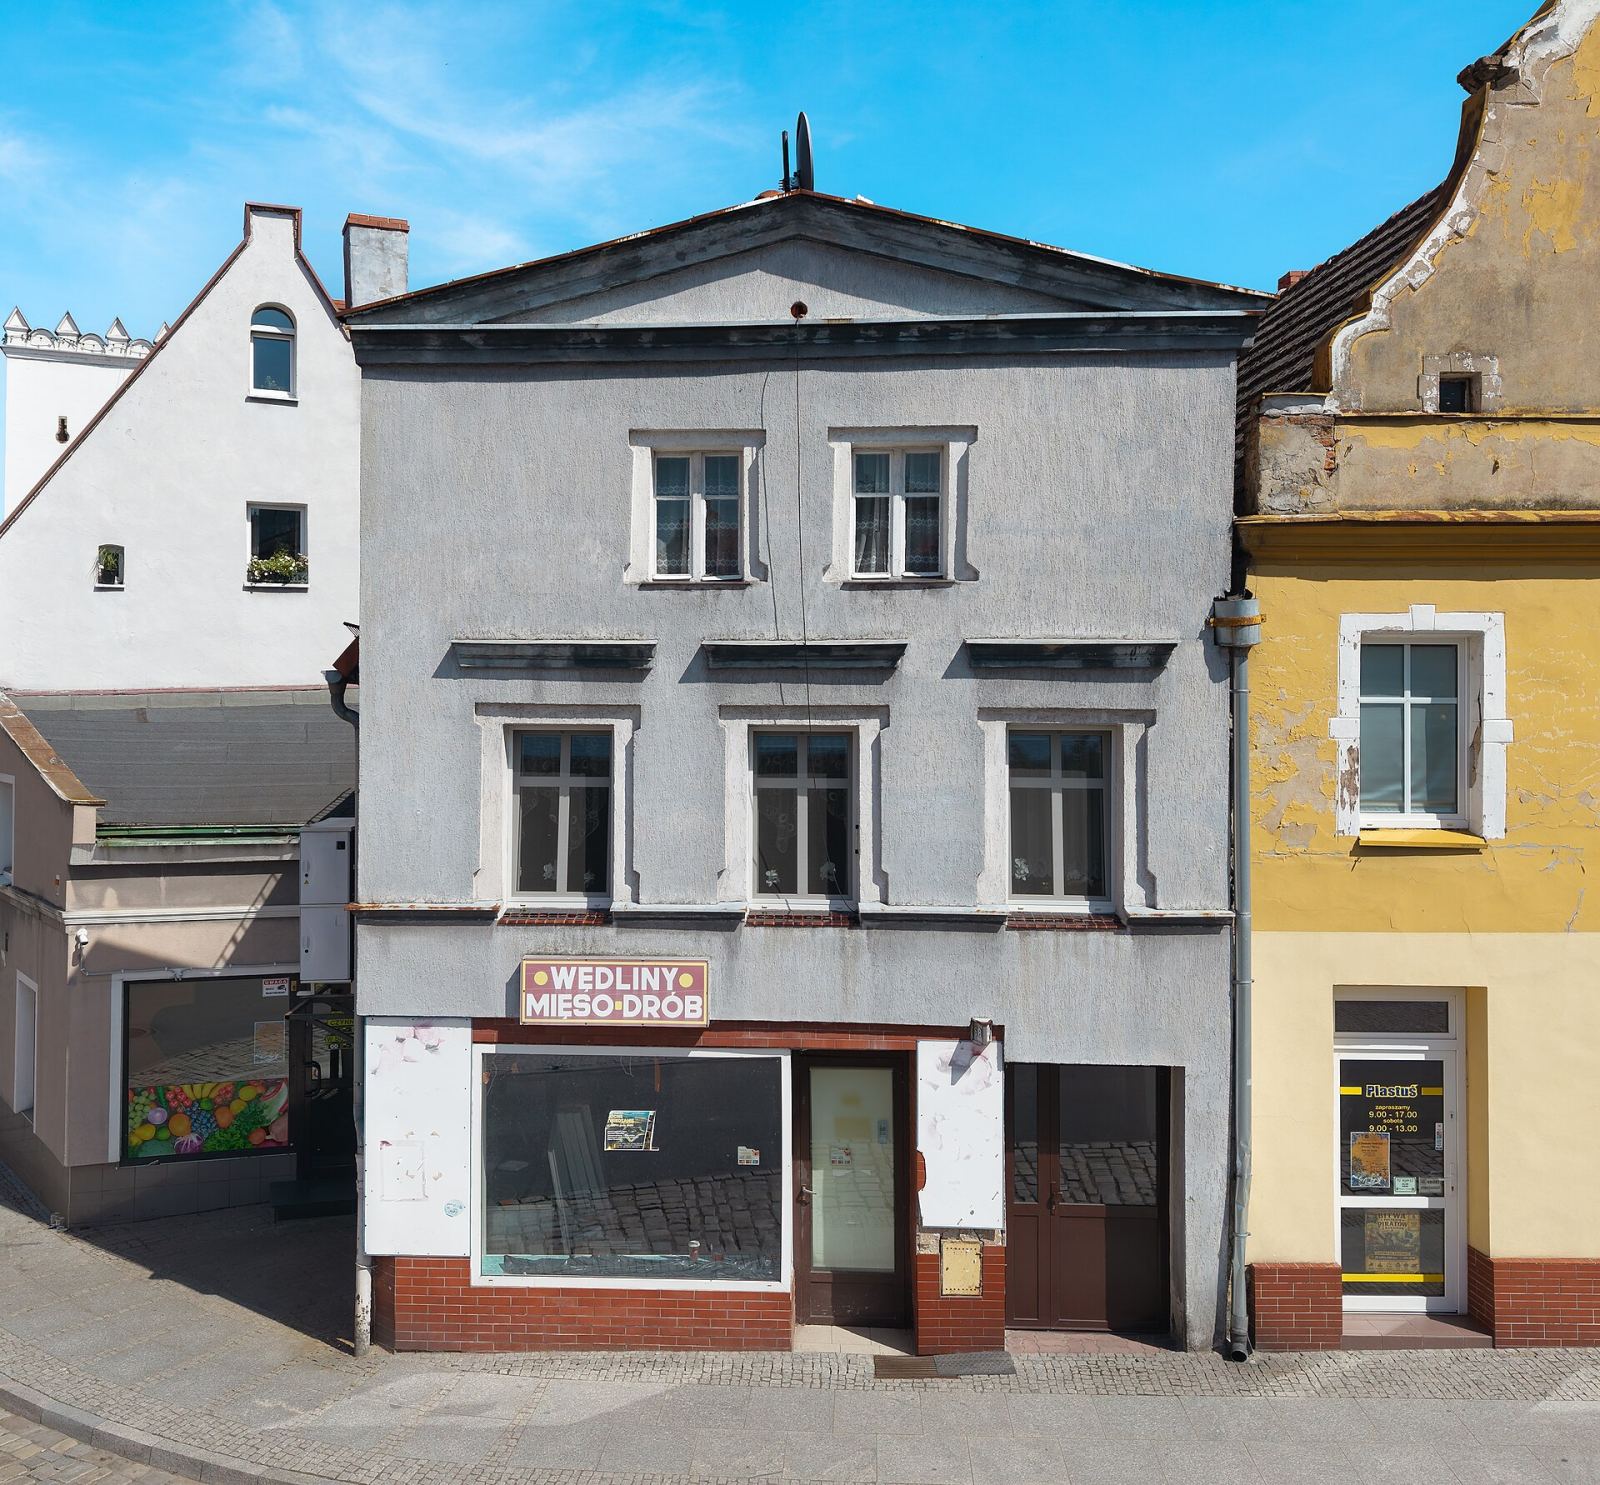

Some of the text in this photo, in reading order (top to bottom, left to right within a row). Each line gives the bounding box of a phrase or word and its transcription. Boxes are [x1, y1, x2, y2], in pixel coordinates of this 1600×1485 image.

[551, 967, 678, 992] WĘDLINY
[526, 992, 702, 1019] MIĘSO DRÓB
[1366, 1084, 1418, 1097] Plastuś
